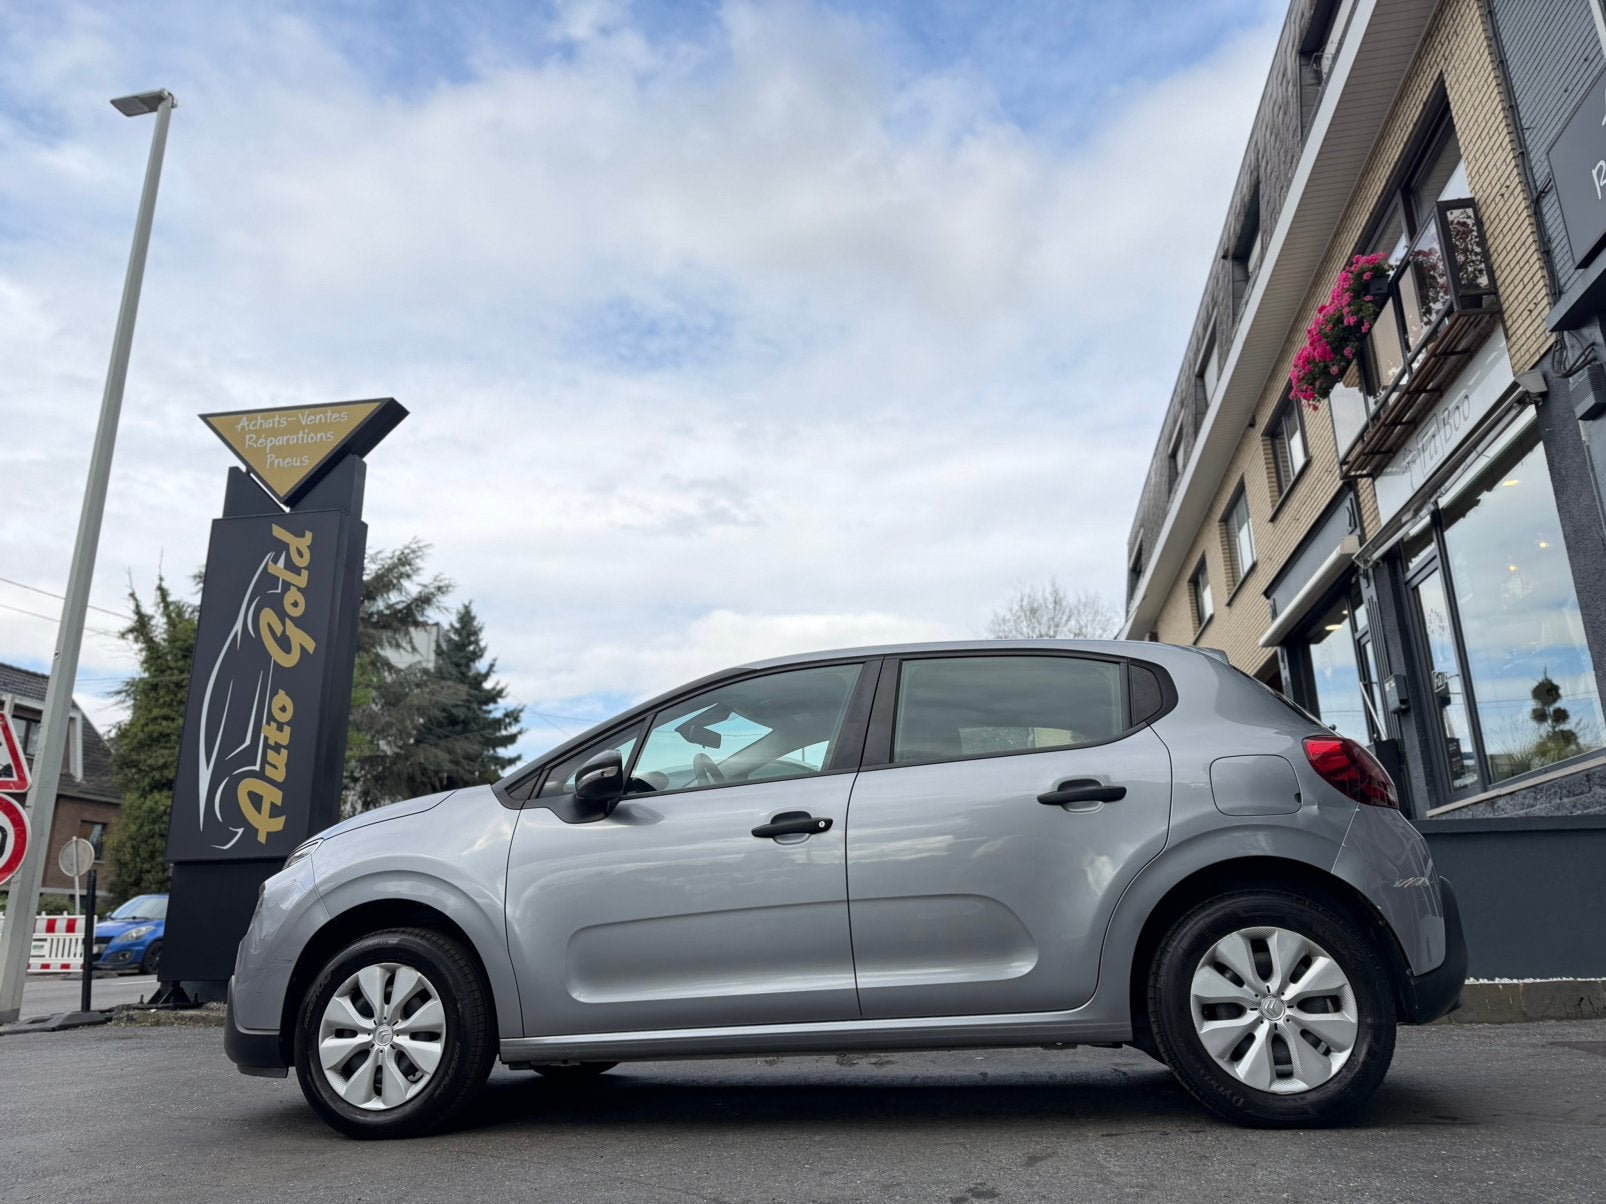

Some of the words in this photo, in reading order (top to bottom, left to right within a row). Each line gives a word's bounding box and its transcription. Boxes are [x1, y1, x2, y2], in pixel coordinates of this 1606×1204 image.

[236, 410, 347, 431] Achats-Ventes
[245, 429, 334, 453] Réparations
[266, 453, 310, 469] Pneus
[259, 523, 316, 667] Gold
[237, 689, 294, 844] Auto
